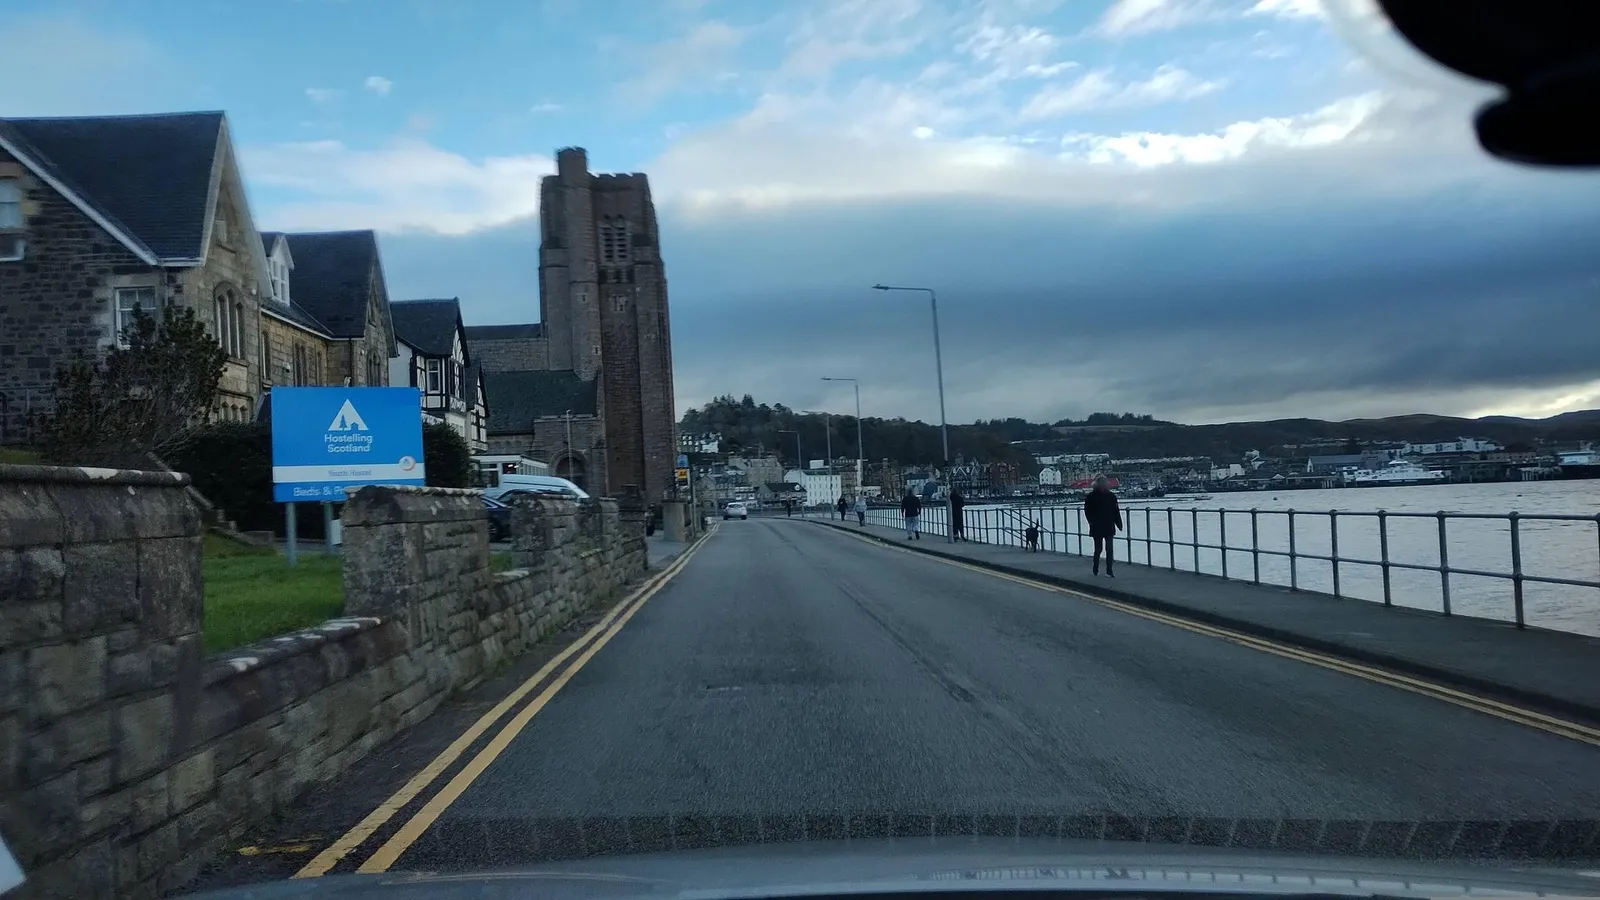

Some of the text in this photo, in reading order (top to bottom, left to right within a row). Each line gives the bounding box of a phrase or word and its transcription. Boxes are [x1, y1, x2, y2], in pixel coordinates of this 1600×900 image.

[324, 434, 373, 444] Hostelling
[327, 443, 371, 453] Scotland
[293, 486, 320, 497] Beds
[322, 486, 332, 496] &
